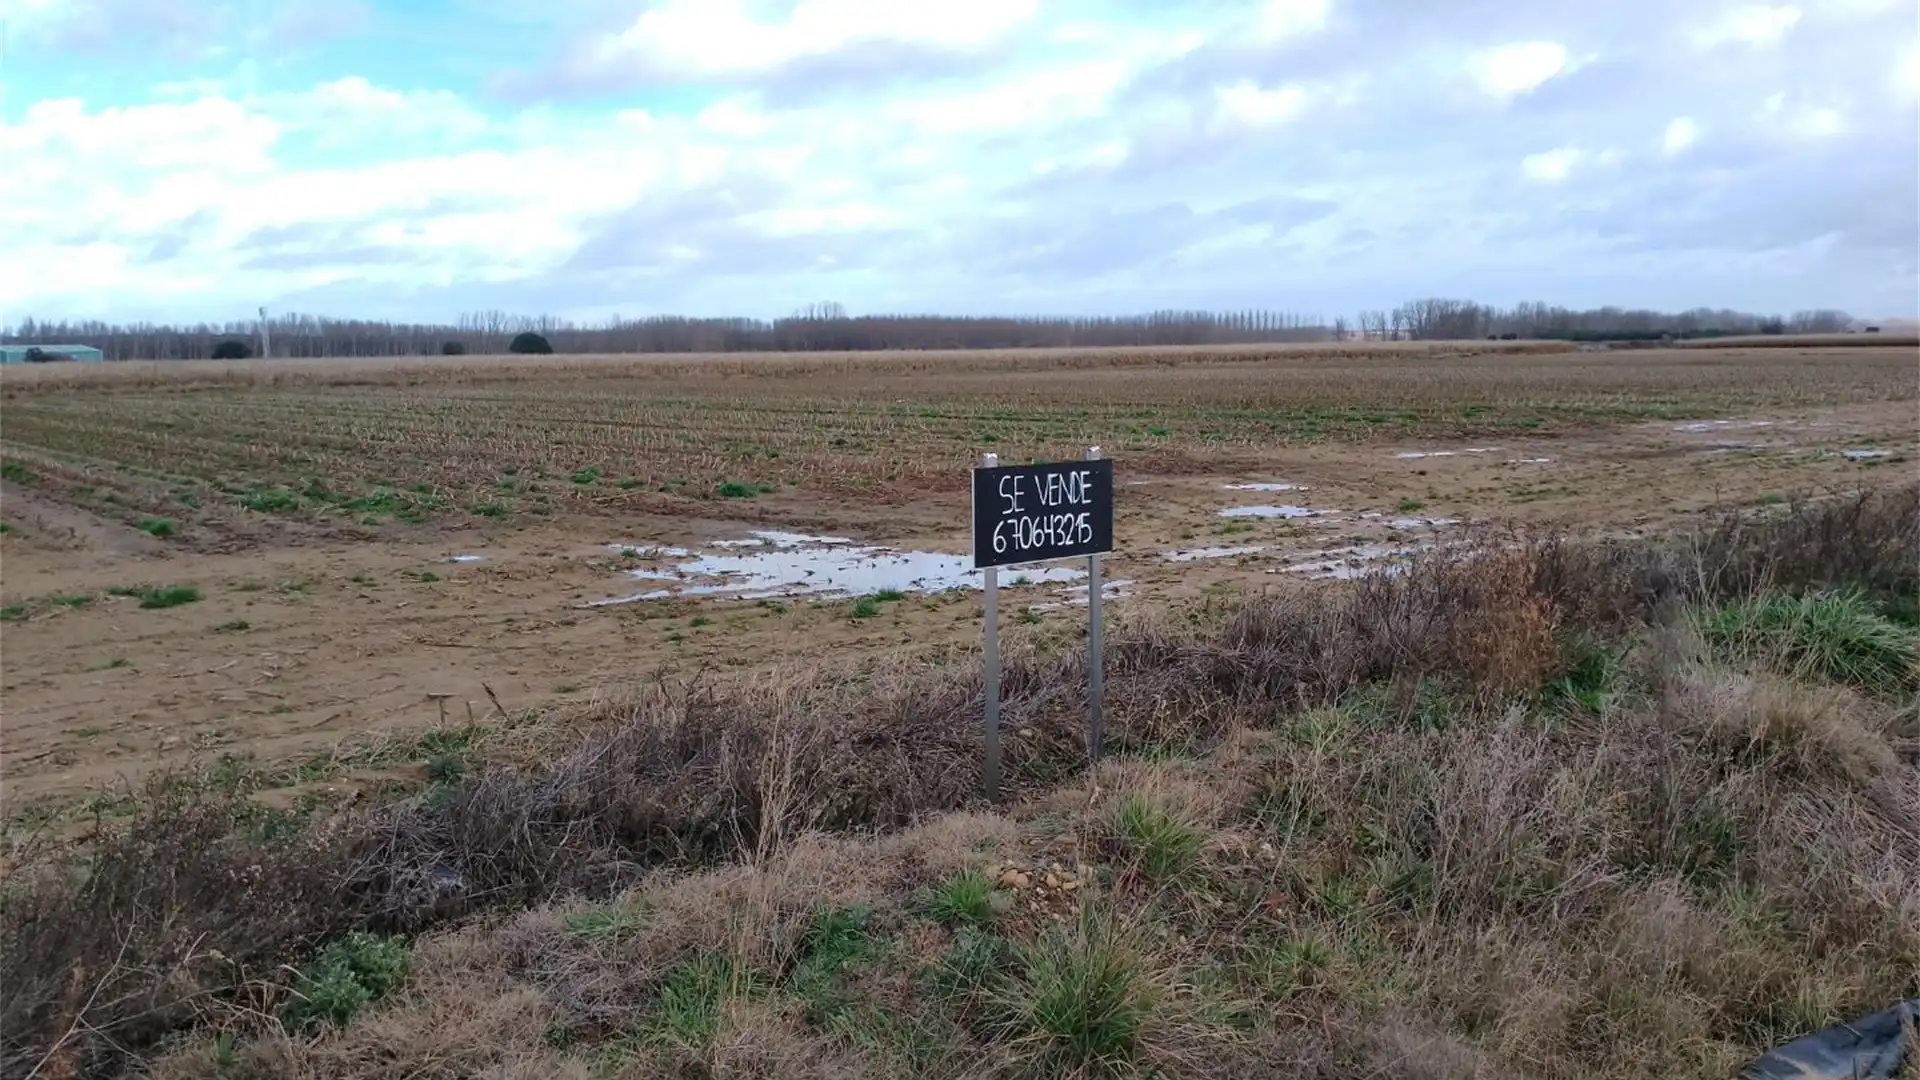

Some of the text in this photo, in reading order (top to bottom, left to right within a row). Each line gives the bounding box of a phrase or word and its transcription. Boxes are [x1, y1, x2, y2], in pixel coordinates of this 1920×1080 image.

[999, 470, 1093, 515] SE VENDE
[992, 512, 1093, 554] 670643215
